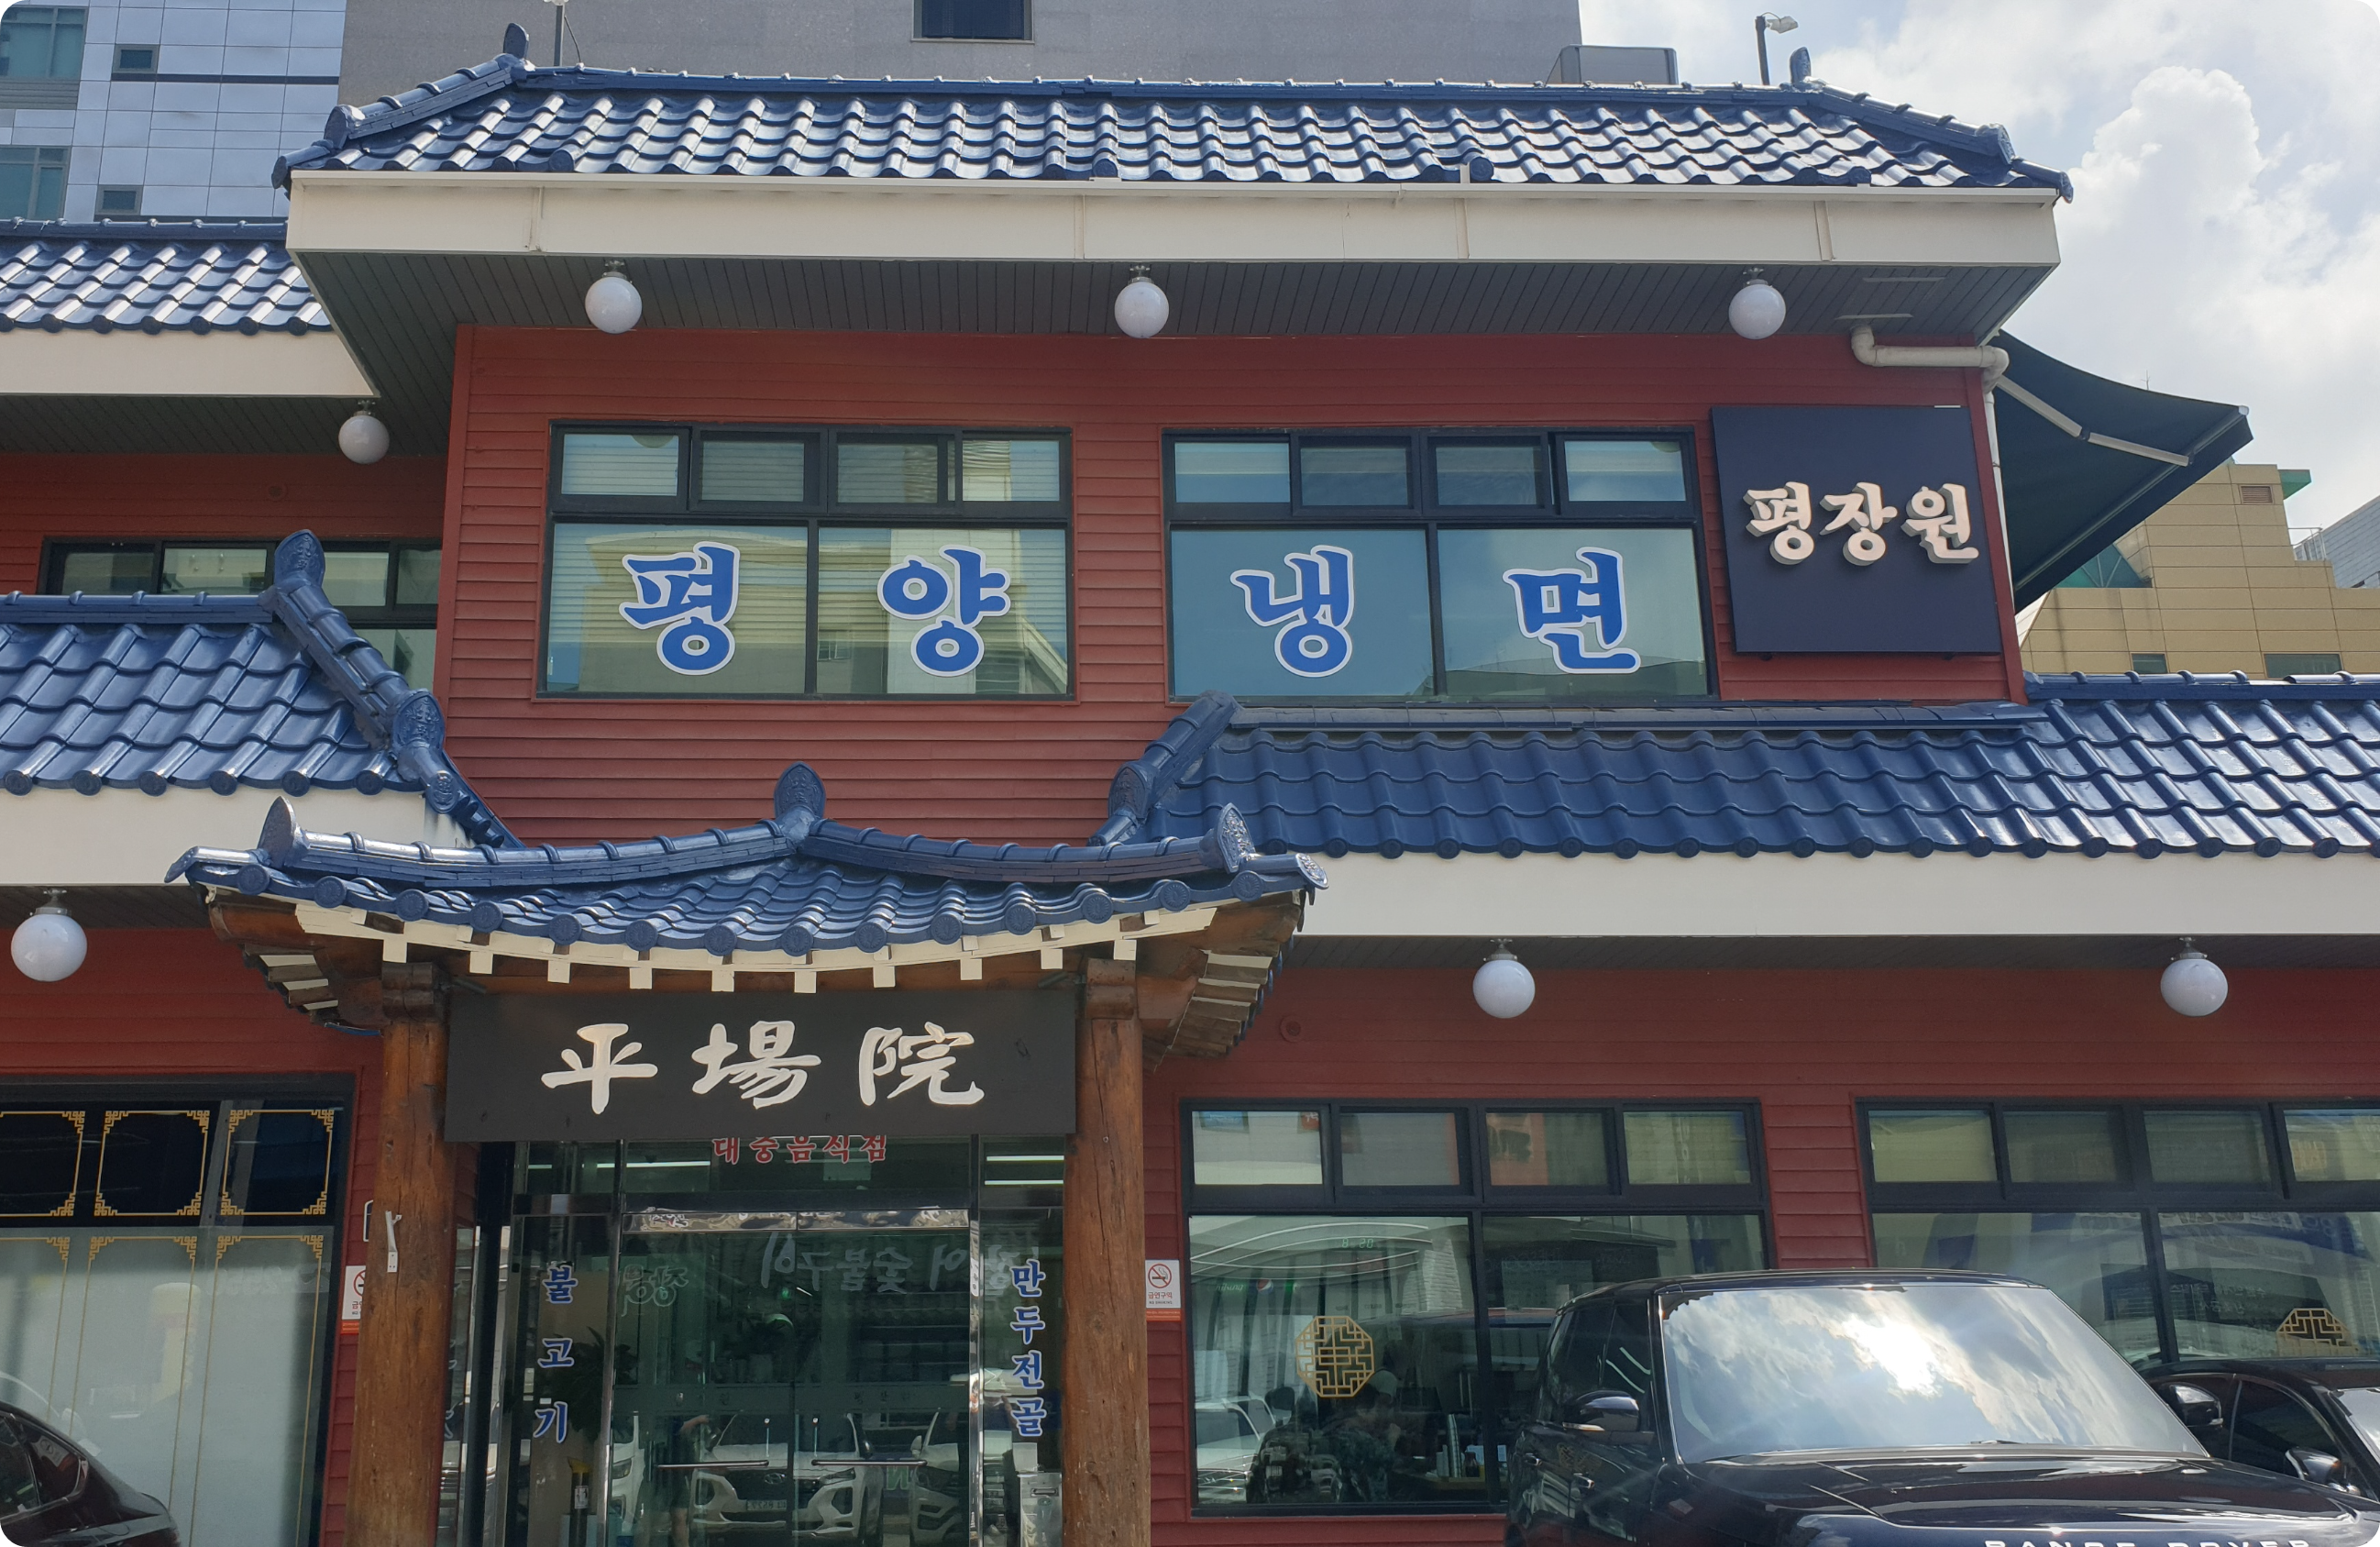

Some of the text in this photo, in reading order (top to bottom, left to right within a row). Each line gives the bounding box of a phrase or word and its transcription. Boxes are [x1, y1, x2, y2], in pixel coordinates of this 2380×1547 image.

[1744, 480, 1980, 566] 평장원
[619, 541, 1641, 678] 평양 냉면
[541, 1021, 985, 1114] 平場院
[711, 1134, 887, 1165] 대중음식점
[1148, 1291, 1173, 1299] 금연구역
[533, 1265, 578, 1443] 불고기
[1009, 1258, 1047, 1437] 만두전골
